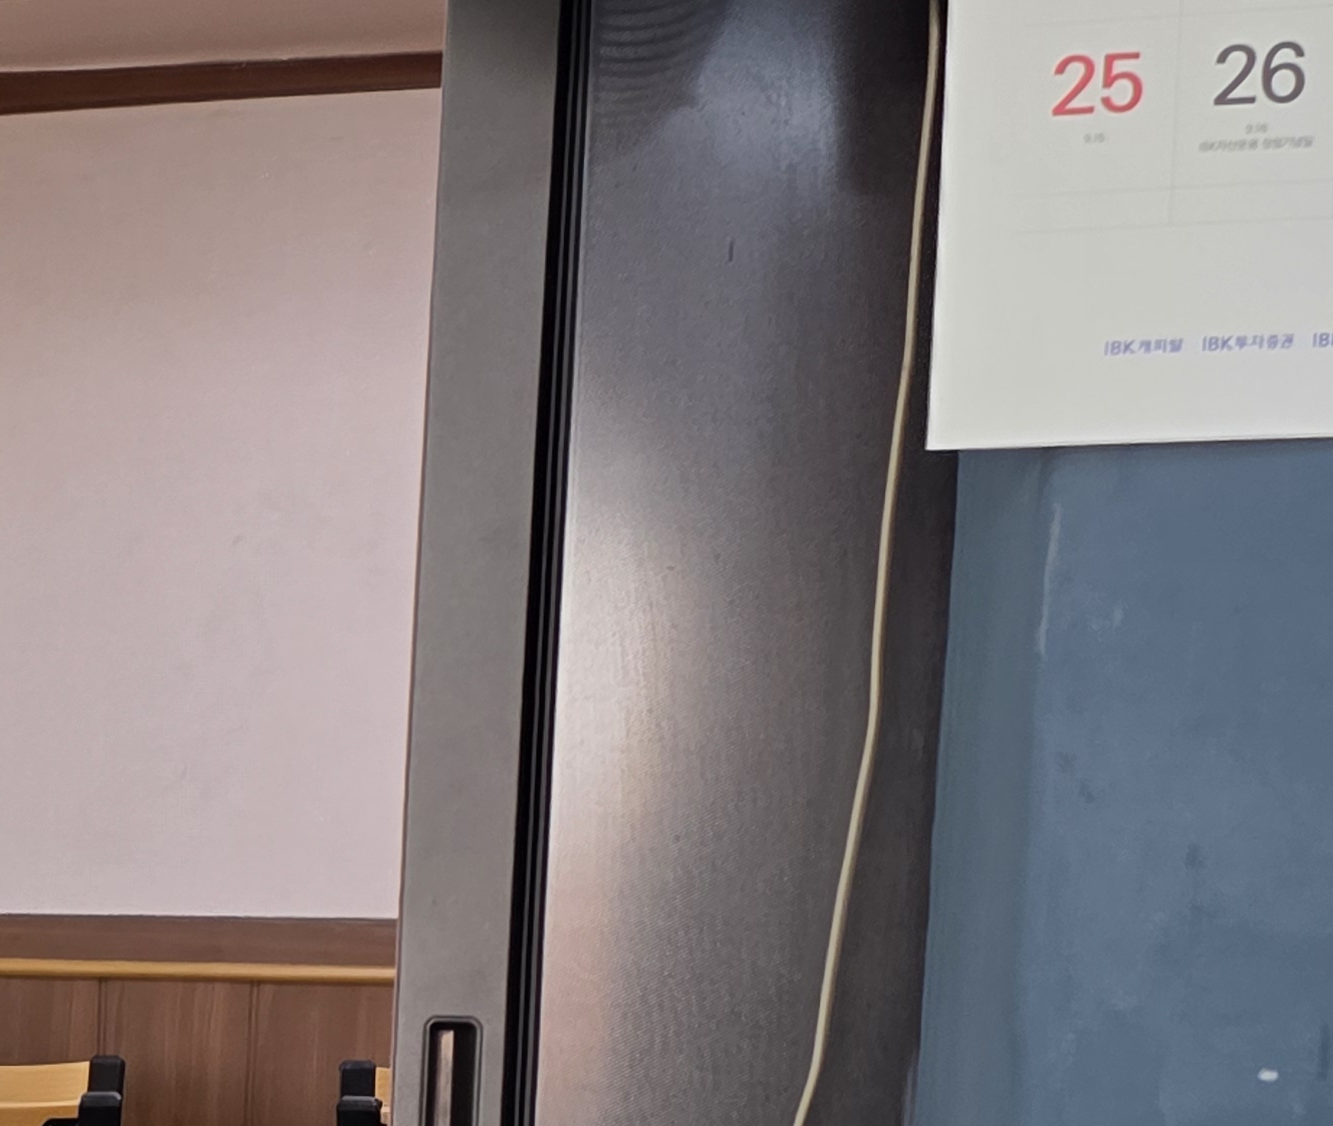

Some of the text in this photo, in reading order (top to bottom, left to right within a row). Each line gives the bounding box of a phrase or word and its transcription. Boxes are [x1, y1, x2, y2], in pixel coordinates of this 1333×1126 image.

[1051, 41, 1306, 116] 25 26
[1201, 332, 1295, 352] IBK투자증권
[1312, 331, 1333, 348] IB
